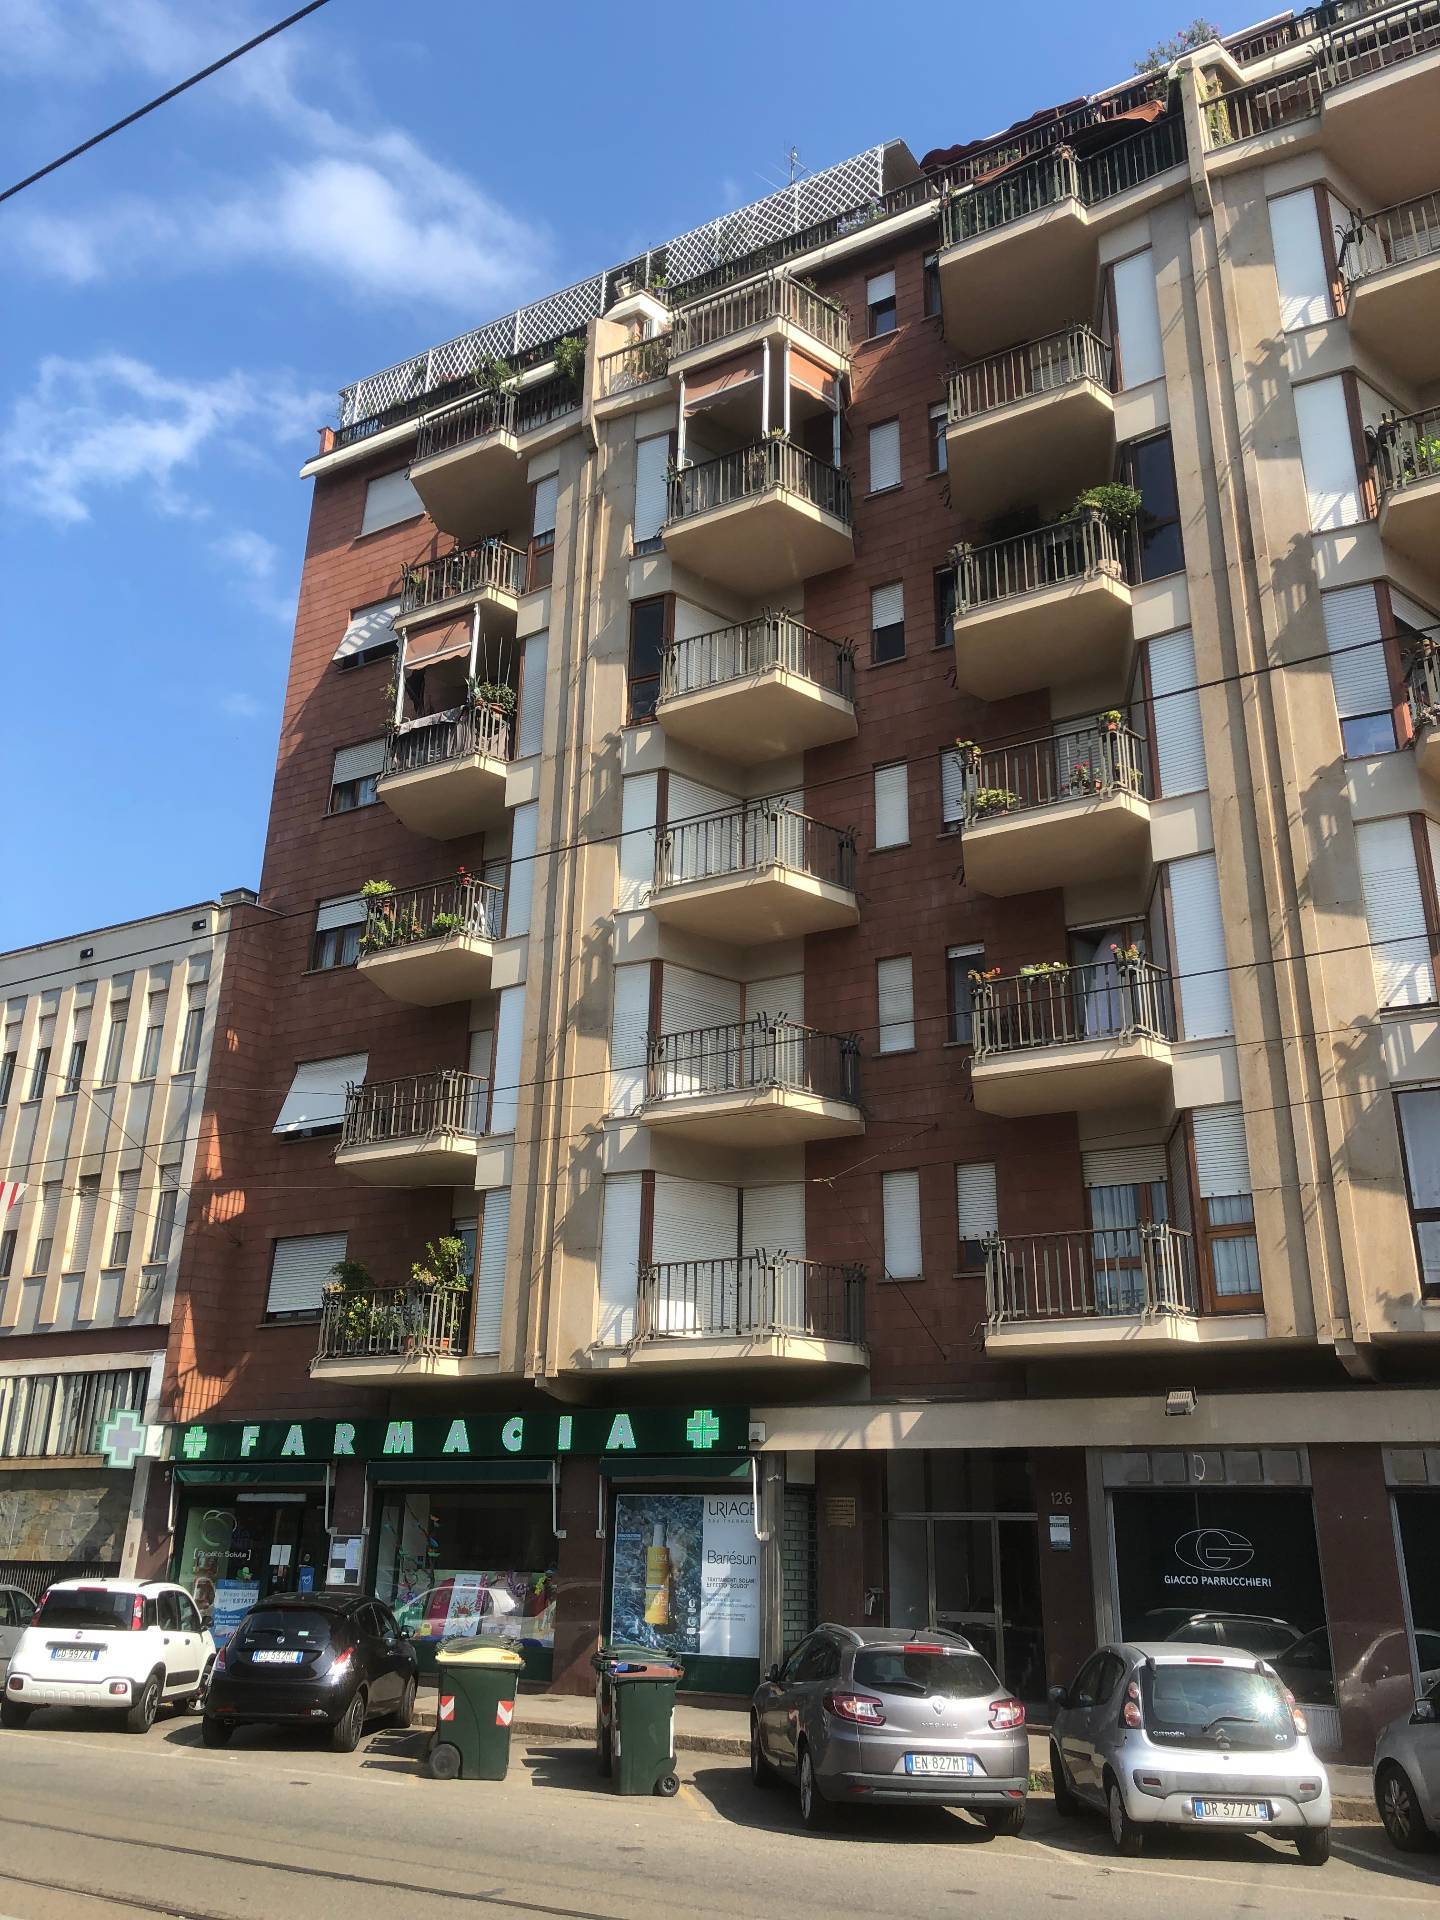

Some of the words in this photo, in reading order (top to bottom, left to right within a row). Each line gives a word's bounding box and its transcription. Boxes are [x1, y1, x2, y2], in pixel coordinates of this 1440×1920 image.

[241, 1414, 636, 1456] FARMACIA
[1051, 1491, 1073, 1505] 126
[708, 1501, 756, 1518] URIAGE
[707, 1549, 757, 1565] Bariésun
[1164, 1575, 1199, 1585] GIACCO
[1201, 1576, 1272, 1587] PARRUCCHIERI
[914, 1756, 928, 1770] EN
[932, 1757, 966, 1771] 827MT
[1204, 1802, 1219, 1816] DR
[1223, 1803, 1258, 1817] 377ZT
